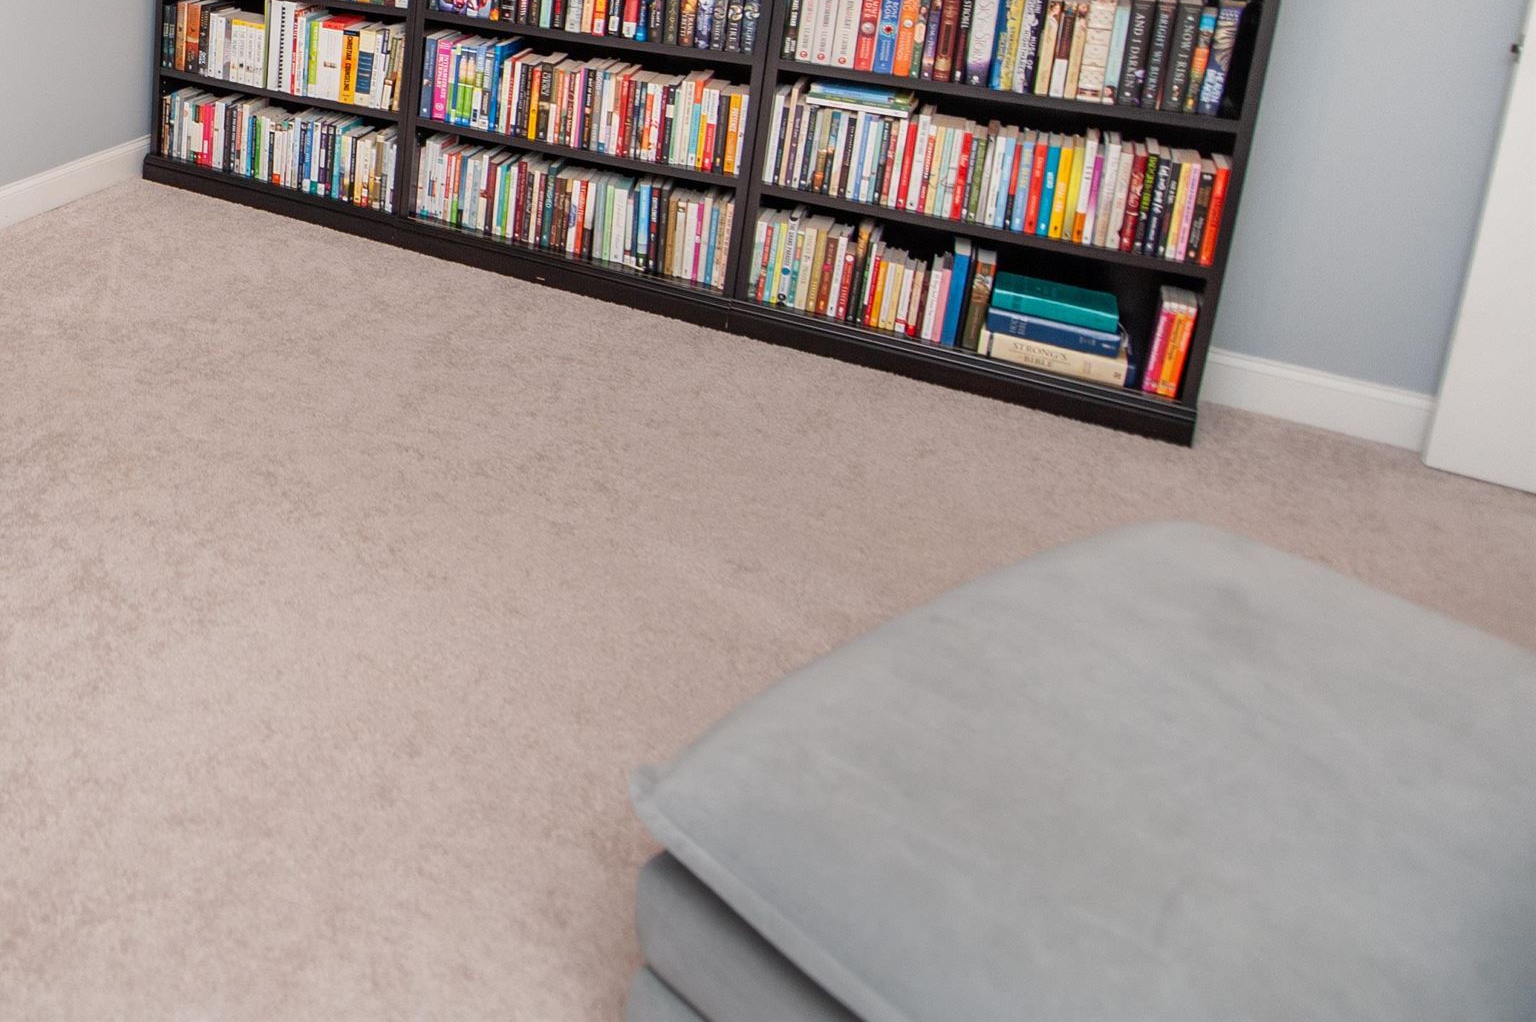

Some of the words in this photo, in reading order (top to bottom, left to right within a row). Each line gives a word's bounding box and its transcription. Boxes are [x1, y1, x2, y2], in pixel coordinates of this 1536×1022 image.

[891, 1, 901, 18] BONE
[960, 0, 972, 28] STROBEL
[977, 1, 996, 23] SKY
[728, 22, 737, 42] FIRE
[745, 20, 754, 46] NIGHT
[1133, 13, 1146, 36] AND
[1155, 14, 1169, 47] BRIGHT
[345, 36, 353, 60] CHRISTIAN
[1029, 36, 1037, 57] MUSE
[1181, 24, 1194, 51] NOW
[1124, 46, 1142, 88] DARKEN
[1153, 51, 1162, 64] WE
[343, 63, 351, 92] COUNSELING
[1147, 67, 1159, 92] BURN
[1173, 61, 1187, 85] RISE
[1212, 72, 1225, 104] HEAVEN
